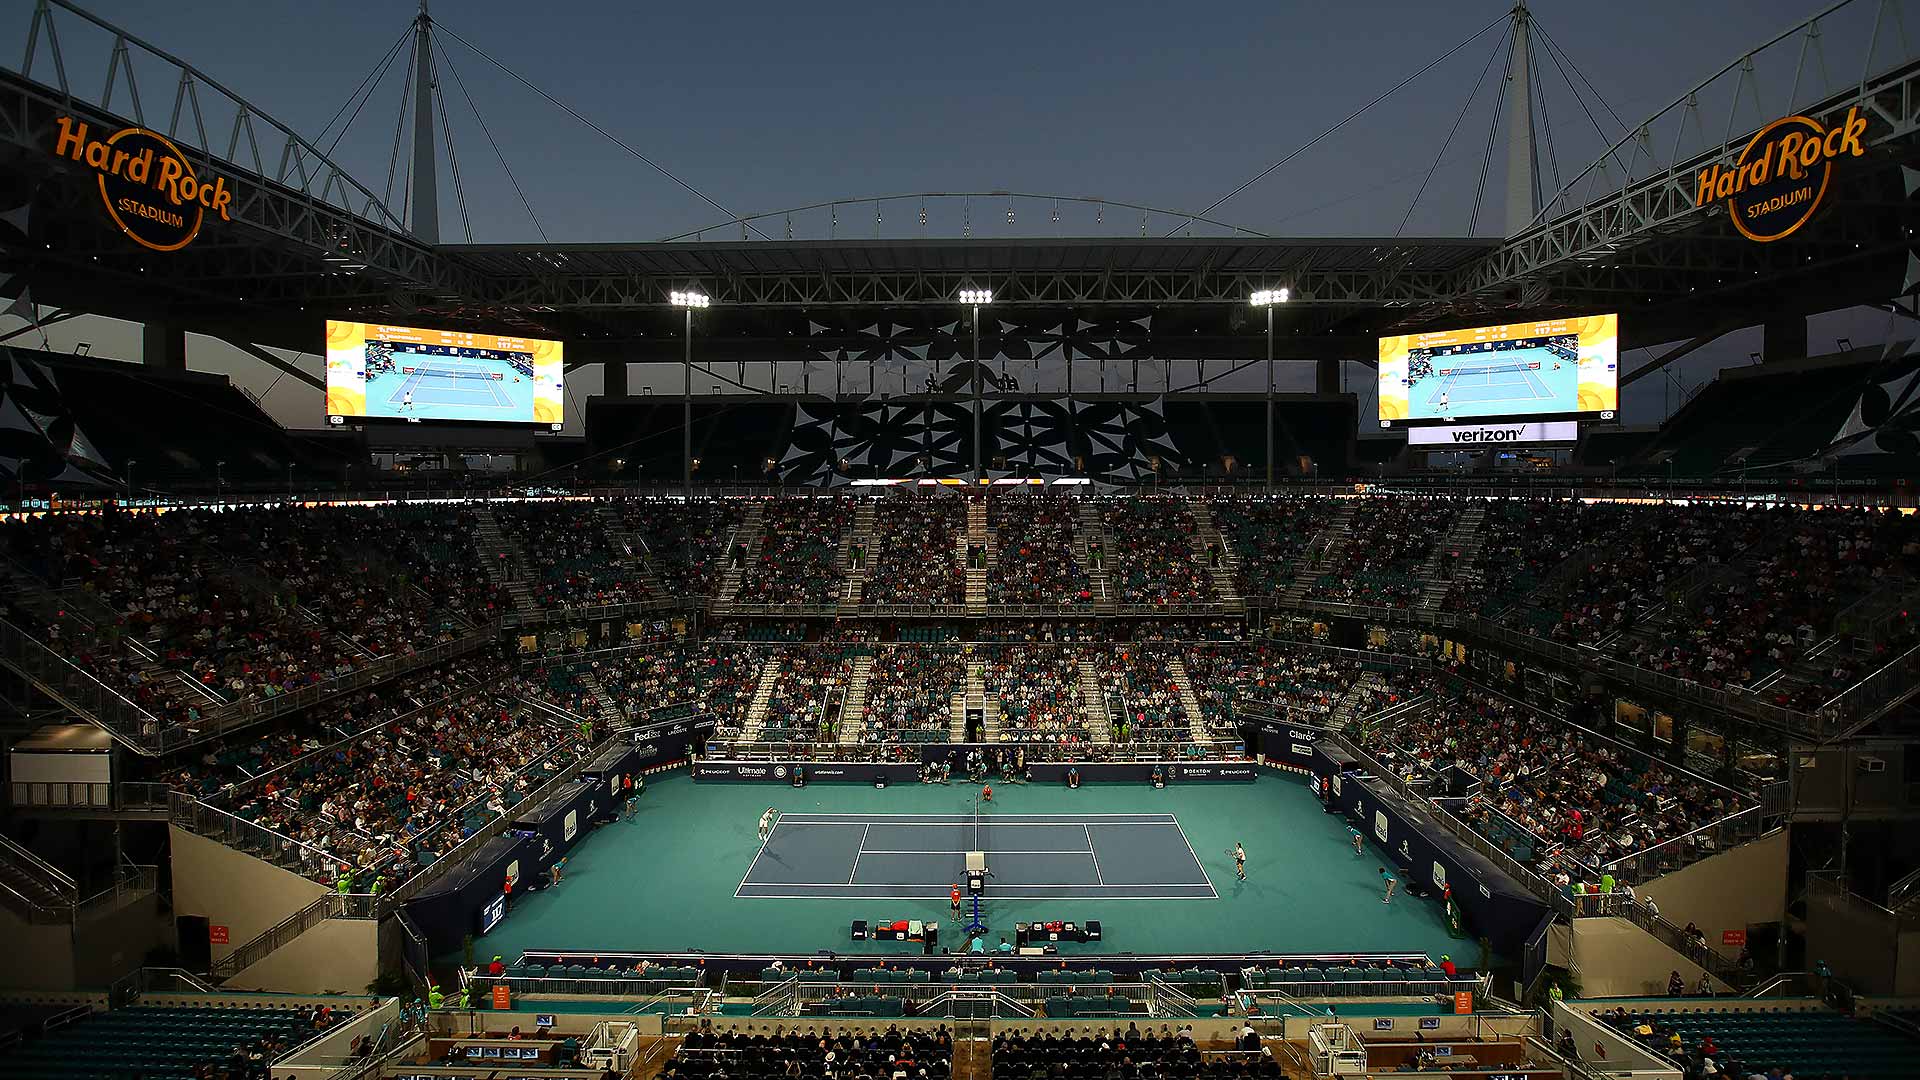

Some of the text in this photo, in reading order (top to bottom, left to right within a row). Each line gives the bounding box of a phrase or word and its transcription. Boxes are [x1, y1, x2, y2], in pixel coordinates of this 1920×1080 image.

[1696, 106, 1867, 206] Hard Rock
[56, 116, 232, 221] Hard Rock
[118, 198, 184, 228] STADIUM
[1452, 427, 1517, 442] verizon
[634, 730, 661, 742] FedEx
[1289, 730, 1312, 742] Claro
[737, 766, 767, 775] Ultimate
